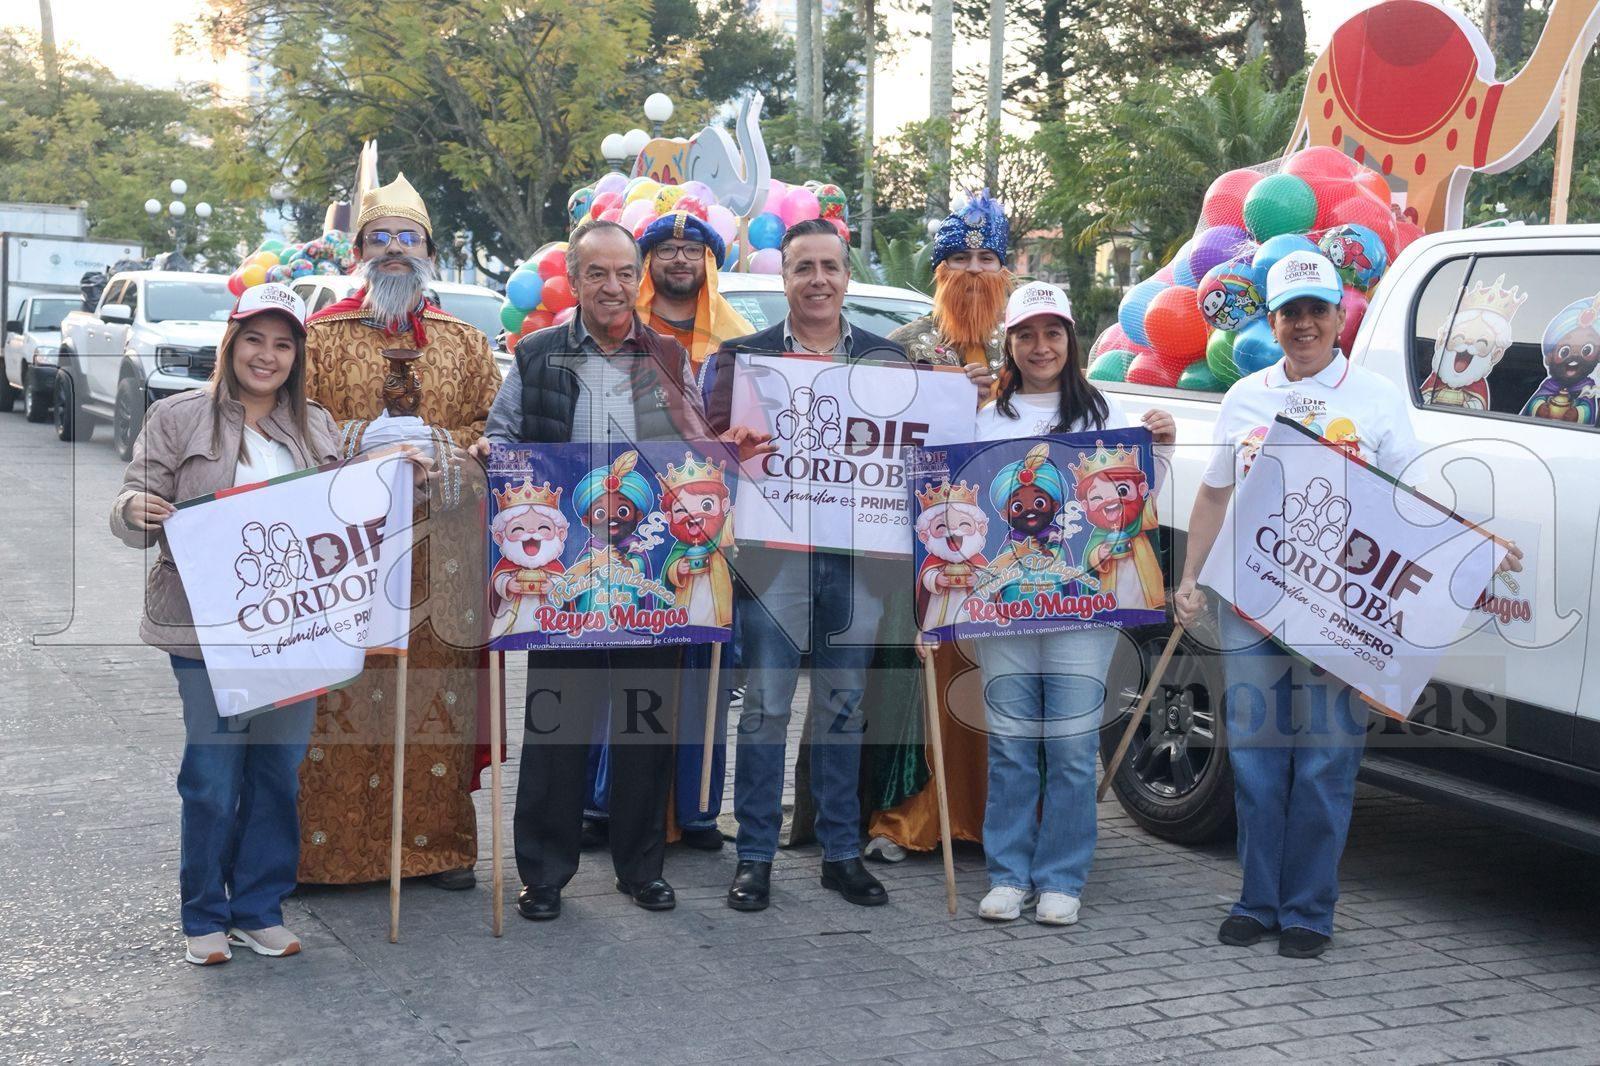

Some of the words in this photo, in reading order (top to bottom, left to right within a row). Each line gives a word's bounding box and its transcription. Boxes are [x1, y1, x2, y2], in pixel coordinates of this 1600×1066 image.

[1300, 263, 1318, 271] DIF
[280, 291, 296, 303] DIF
[1038, 289, 1054, 297] DIF
[845, 417, 929, 460] DIF
[762, 449, 907, 488] CÓRDOB
[763, 487, 780, 500] La
[784, 489, 838, 507] familia
[841, 497, 856, 508] es
[857, 512, 911, 526] 2026-20
[306, 515, 387, 579] DIF
[1334, 528, 1434, 601] DIF
[1256, 526, 1406, 638] CÓRDOBA
[534, 604, 606, 637] Reyes
[607, 604, 689, 634] Magos
[963, 596, 1034, 627] Reyes
[1034, 591, 1118, 620] Magos
[1245, 555, 1261, 573] La
[1261, 571, 1310, 605] familia
[1310, 602, 1327, 618] es
[1328, 612, 1394, 659] PRIMERO.
[250, 643, 271, 658] La
[276, 622, 332, 654] familia
[334, 619, 351, 632] es
[654, 637, 662, 645] de
[1320, 627, 1386, 671] 2026-2029
